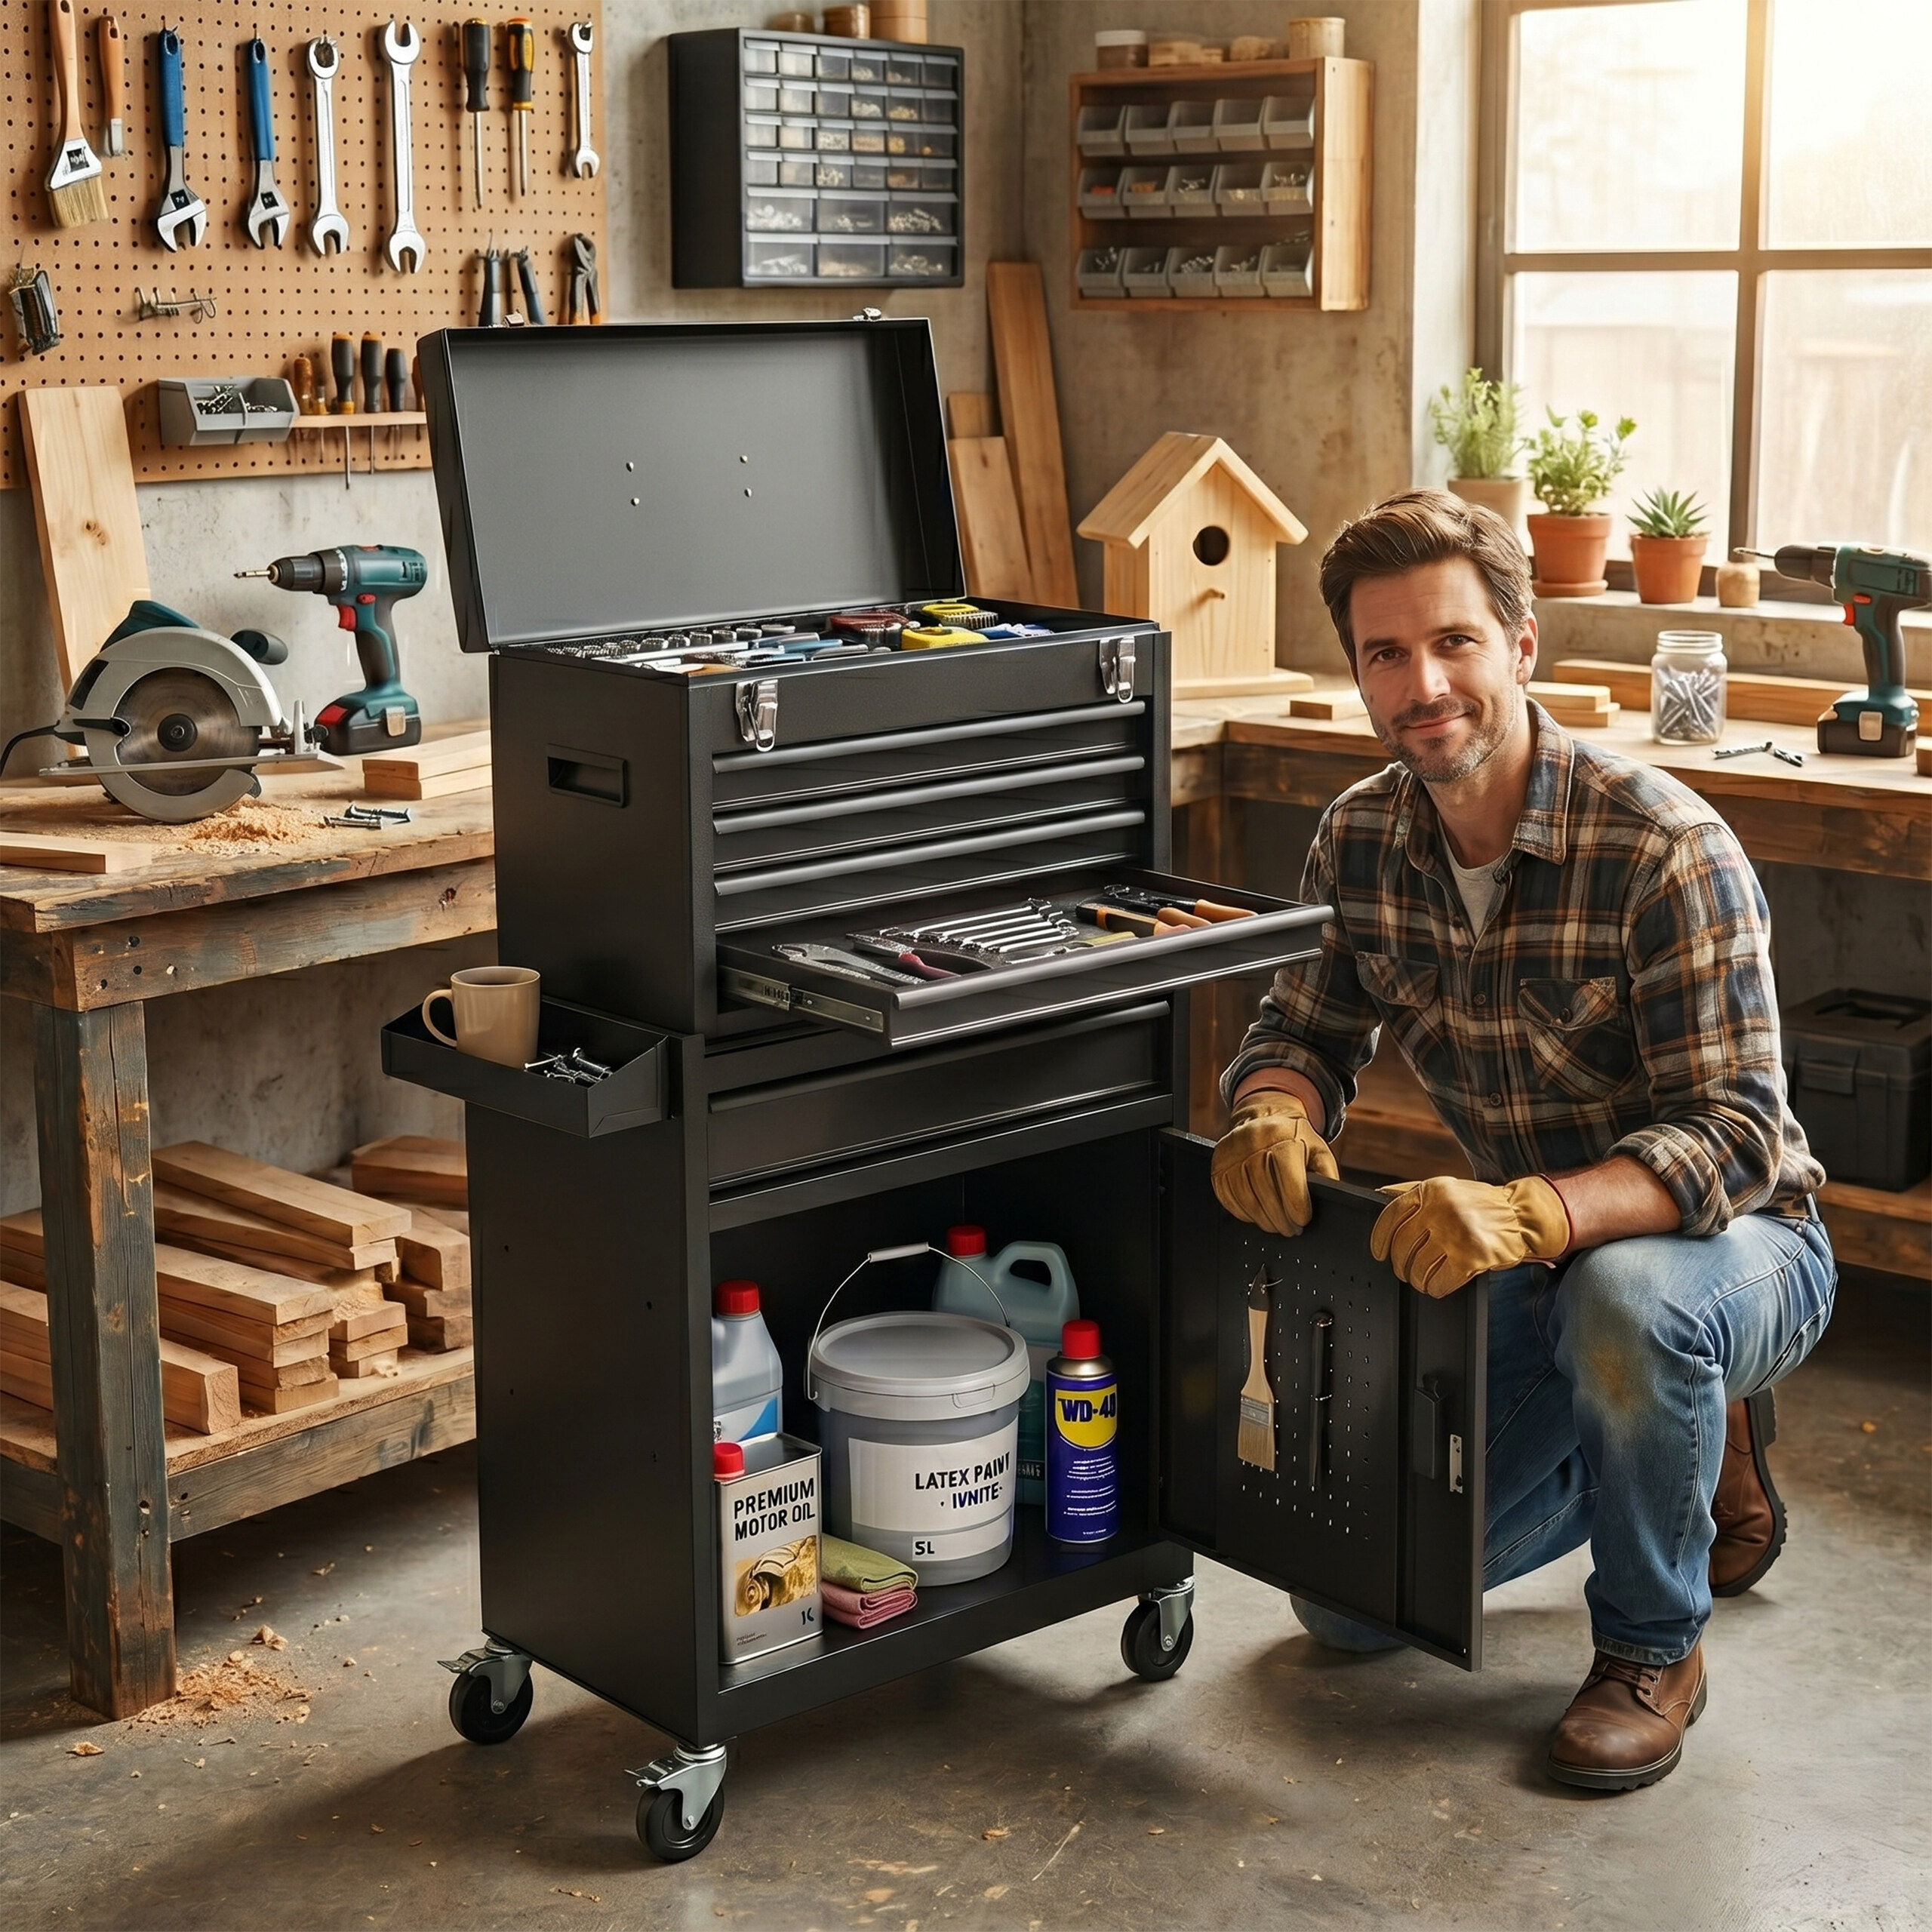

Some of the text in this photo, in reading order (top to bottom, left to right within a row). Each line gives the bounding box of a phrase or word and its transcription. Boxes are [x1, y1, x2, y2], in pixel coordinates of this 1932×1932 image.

[734, 1477, 814, 1520] PREMIUM
[915, 1468, 970, 1491] LATEX
[734, 1502, 816, 1541] MOTOR OIL
